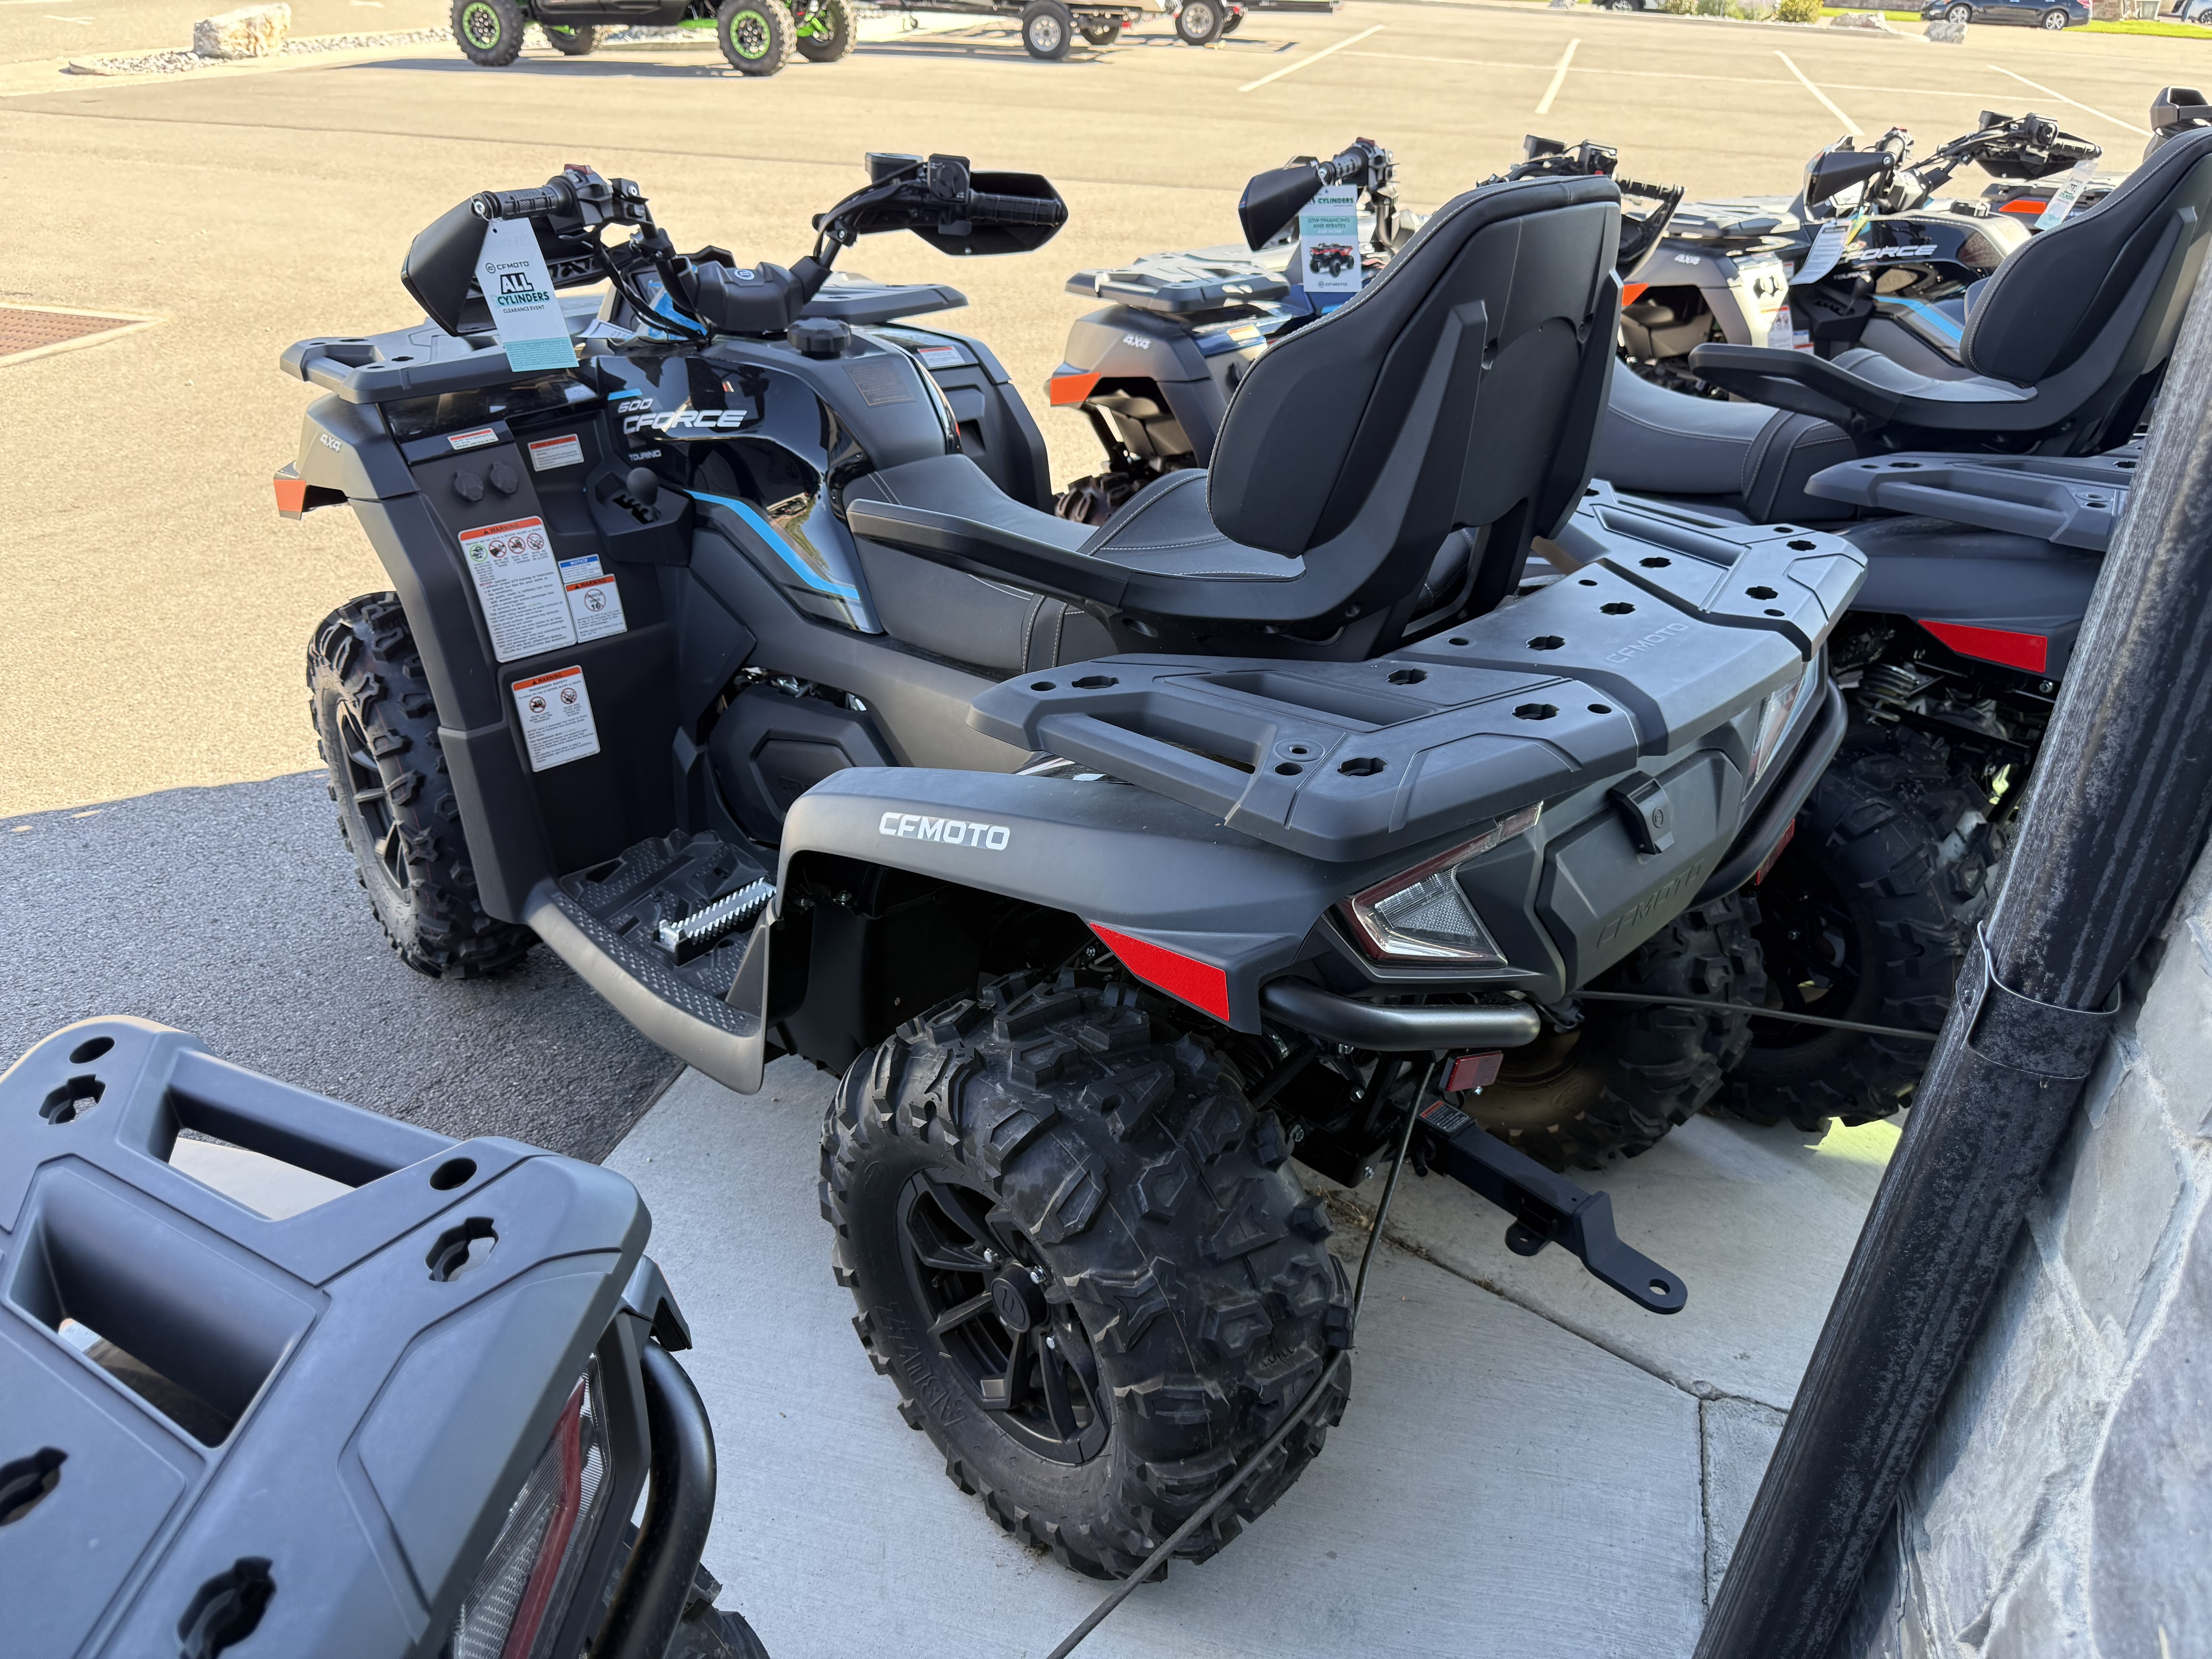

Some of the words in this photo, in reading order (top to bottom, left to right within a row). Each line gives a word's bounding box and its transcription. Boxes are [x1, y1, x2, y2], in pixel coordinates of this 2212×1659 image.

[496, 261, 529, 270] CFMOTO
[501, 274, 532, 293] ALL
[498, 292, 550, 305] CYLINDERS
[618, 398, 653, 413] 600
[623, 410, 747, 434] CFORCE
[629, 449, 661, 461] TOURING
[490, 524, 519, 533] WARNING
[581, 578, 606, 587] WARNING
[1605, 623, 1688, 663] CFMOTO
[538, 673, 562, 683] WARNING
[879, 812, 1010, 850] CFMOTO
[1596, 858, 1705, 948] CFMOTO
